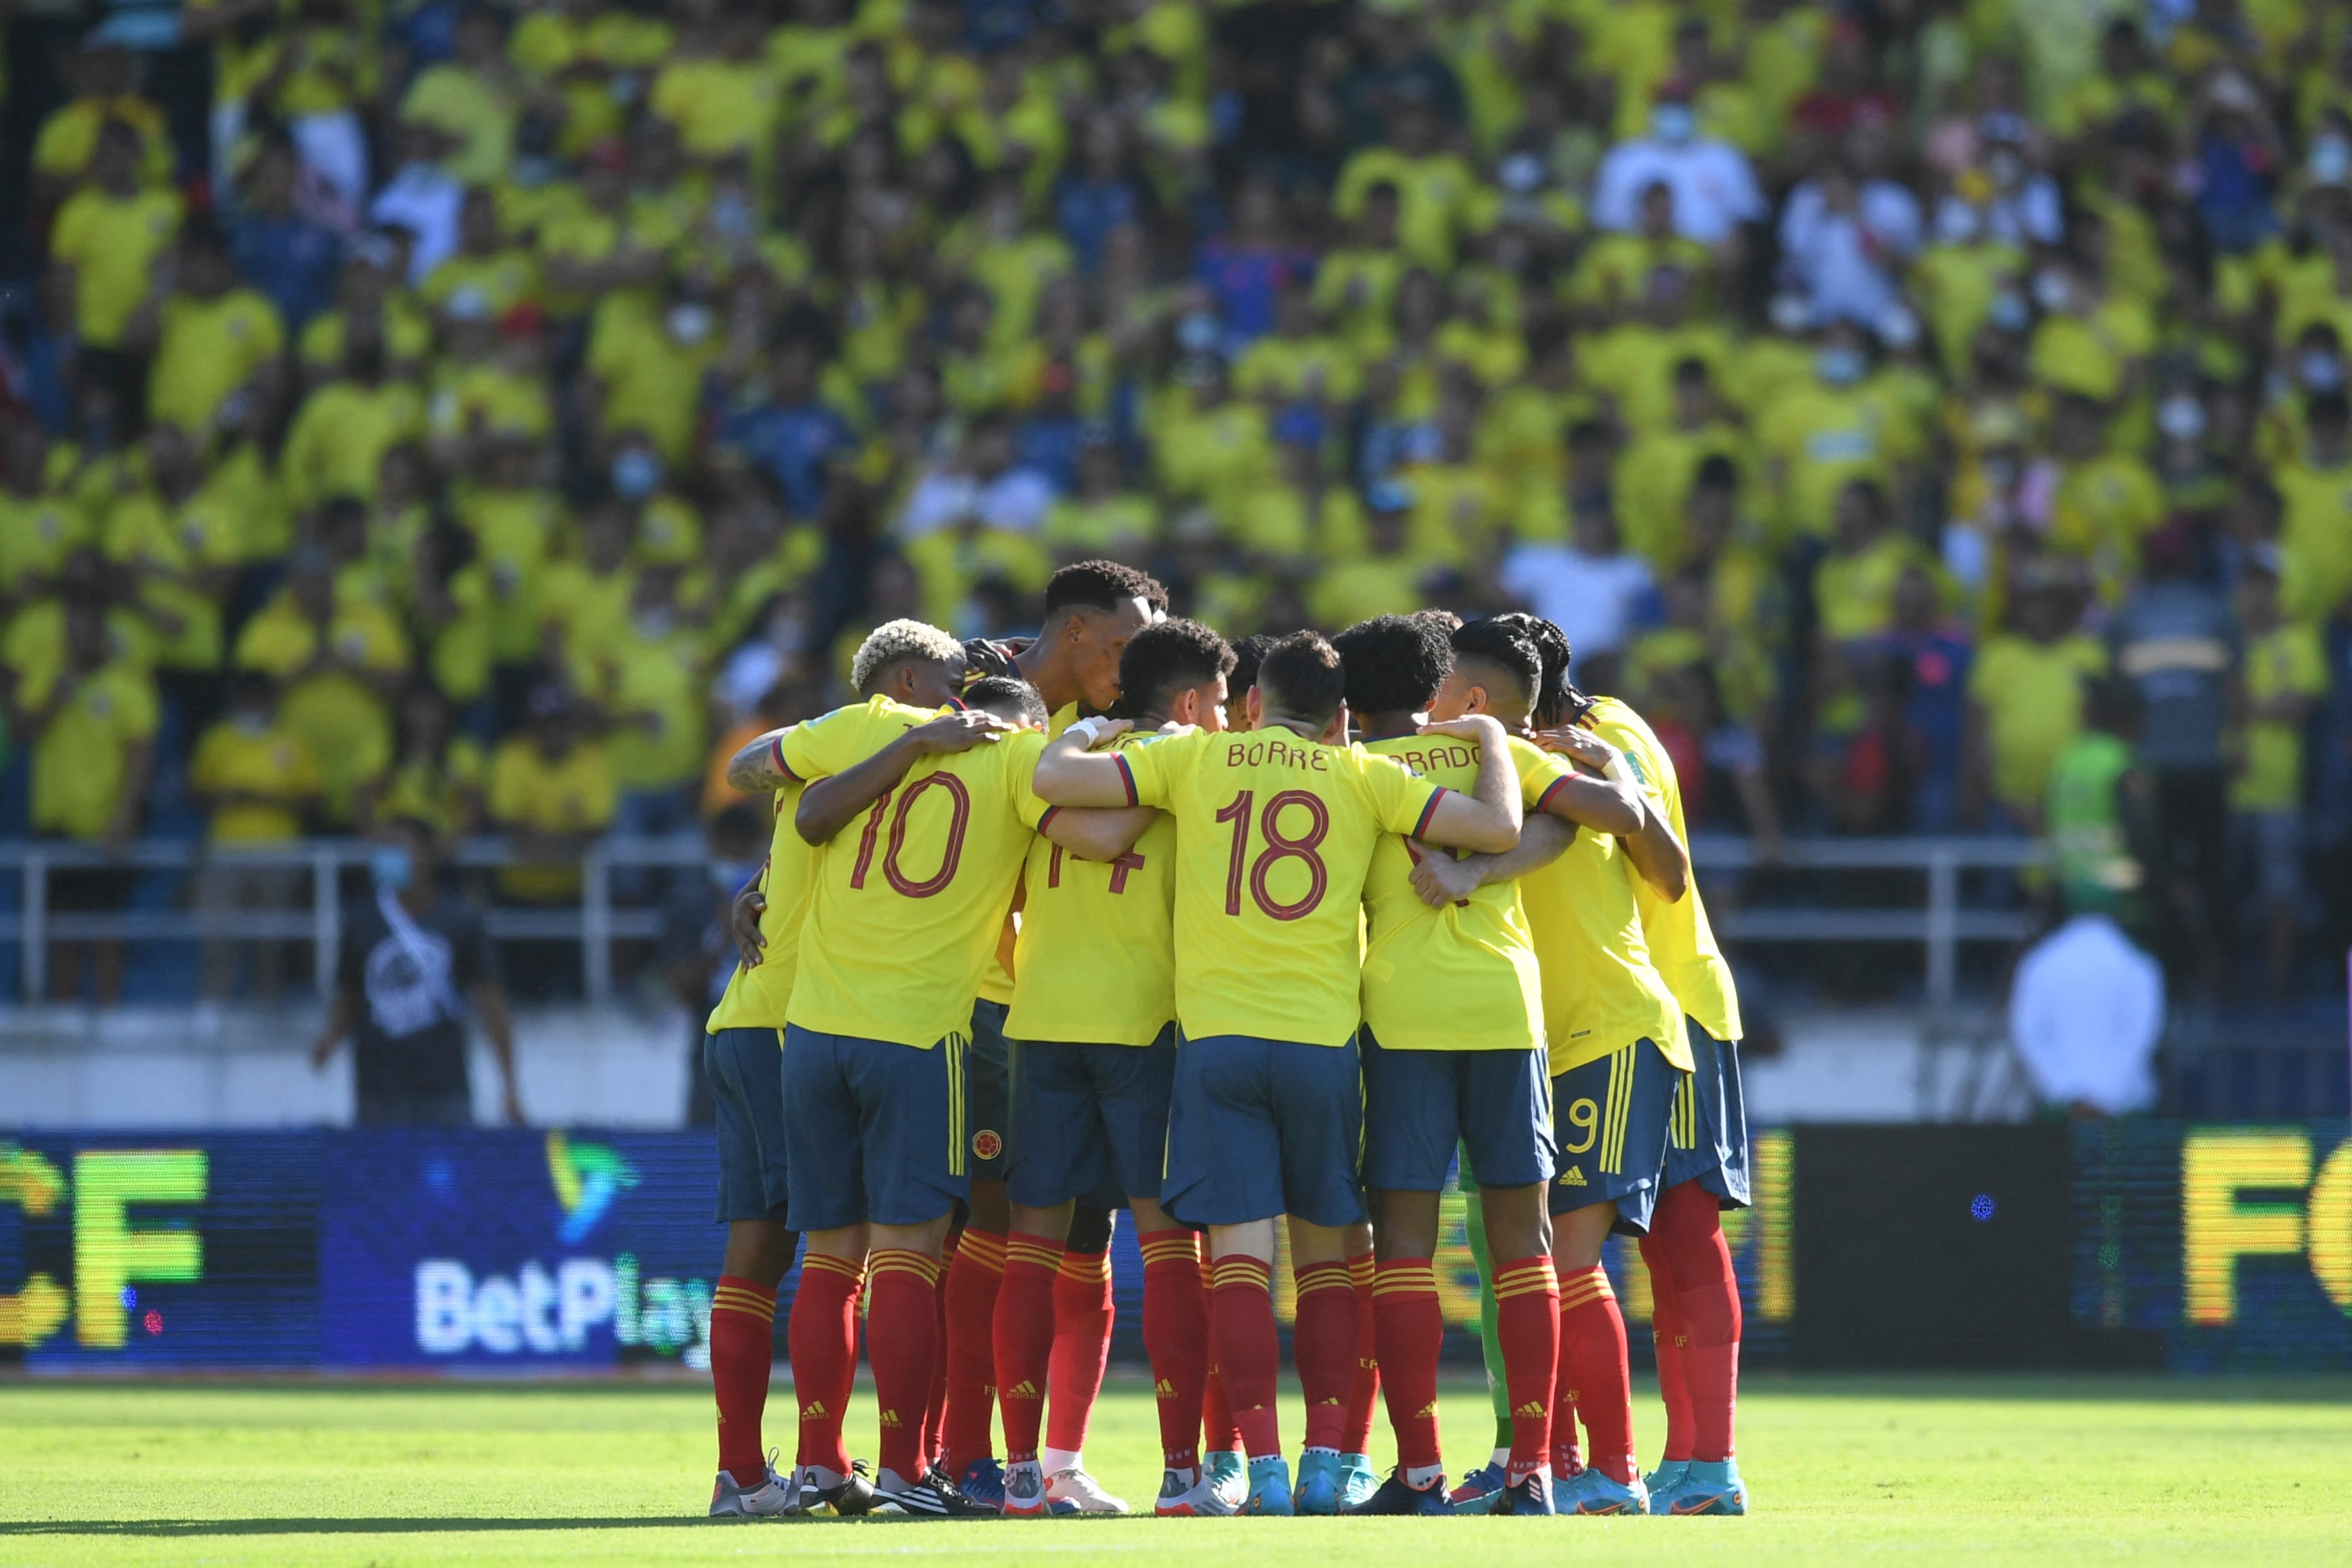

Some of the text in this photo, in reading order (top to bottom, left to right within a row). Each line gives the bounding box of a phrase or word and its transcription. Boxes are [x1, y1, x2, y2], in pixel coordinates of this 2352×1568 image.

[1227, 741, 1329, 772] BORRE
[850, 770, 971, 899] 10
[1215, 789, 1330, 921] 18
[1565, 1097, 1598, 1154] 9
[1559, 1177, 1588, 1186] adidas
